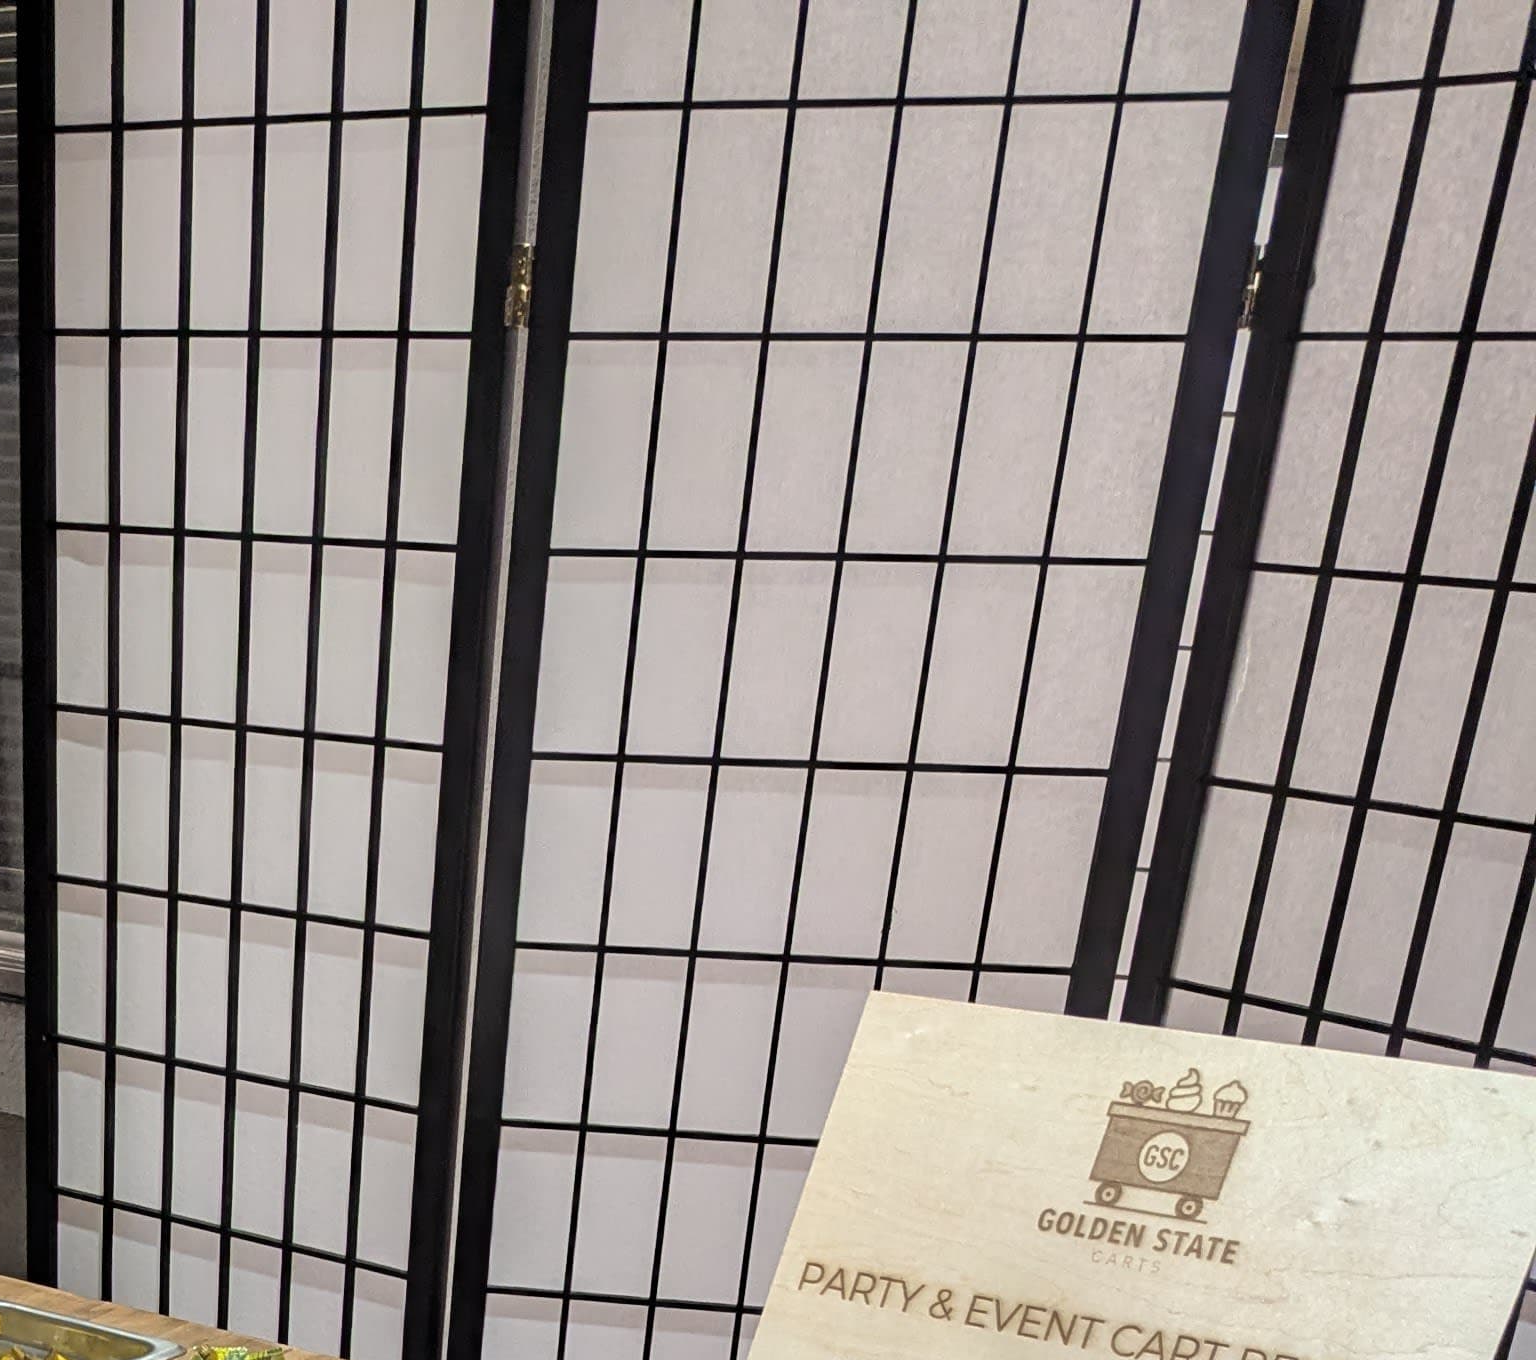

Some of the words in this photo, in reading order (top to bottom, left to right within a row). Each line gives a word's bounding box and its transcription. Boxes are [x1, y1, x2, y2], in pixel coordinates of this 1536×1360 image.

[1142, 1143, 1184, 1172] GSC
[1036, 1207, 1147, 1249] GOLDEN
[1151, 1227, 1241, 1265] STATE
[1090, 1249, 1163, 1275] CARTS
[797, 1261, 926, 1313] PARTY
[928, 1288, 954, 1322] &
[964, 1294, 1106, 1350] EVENT
